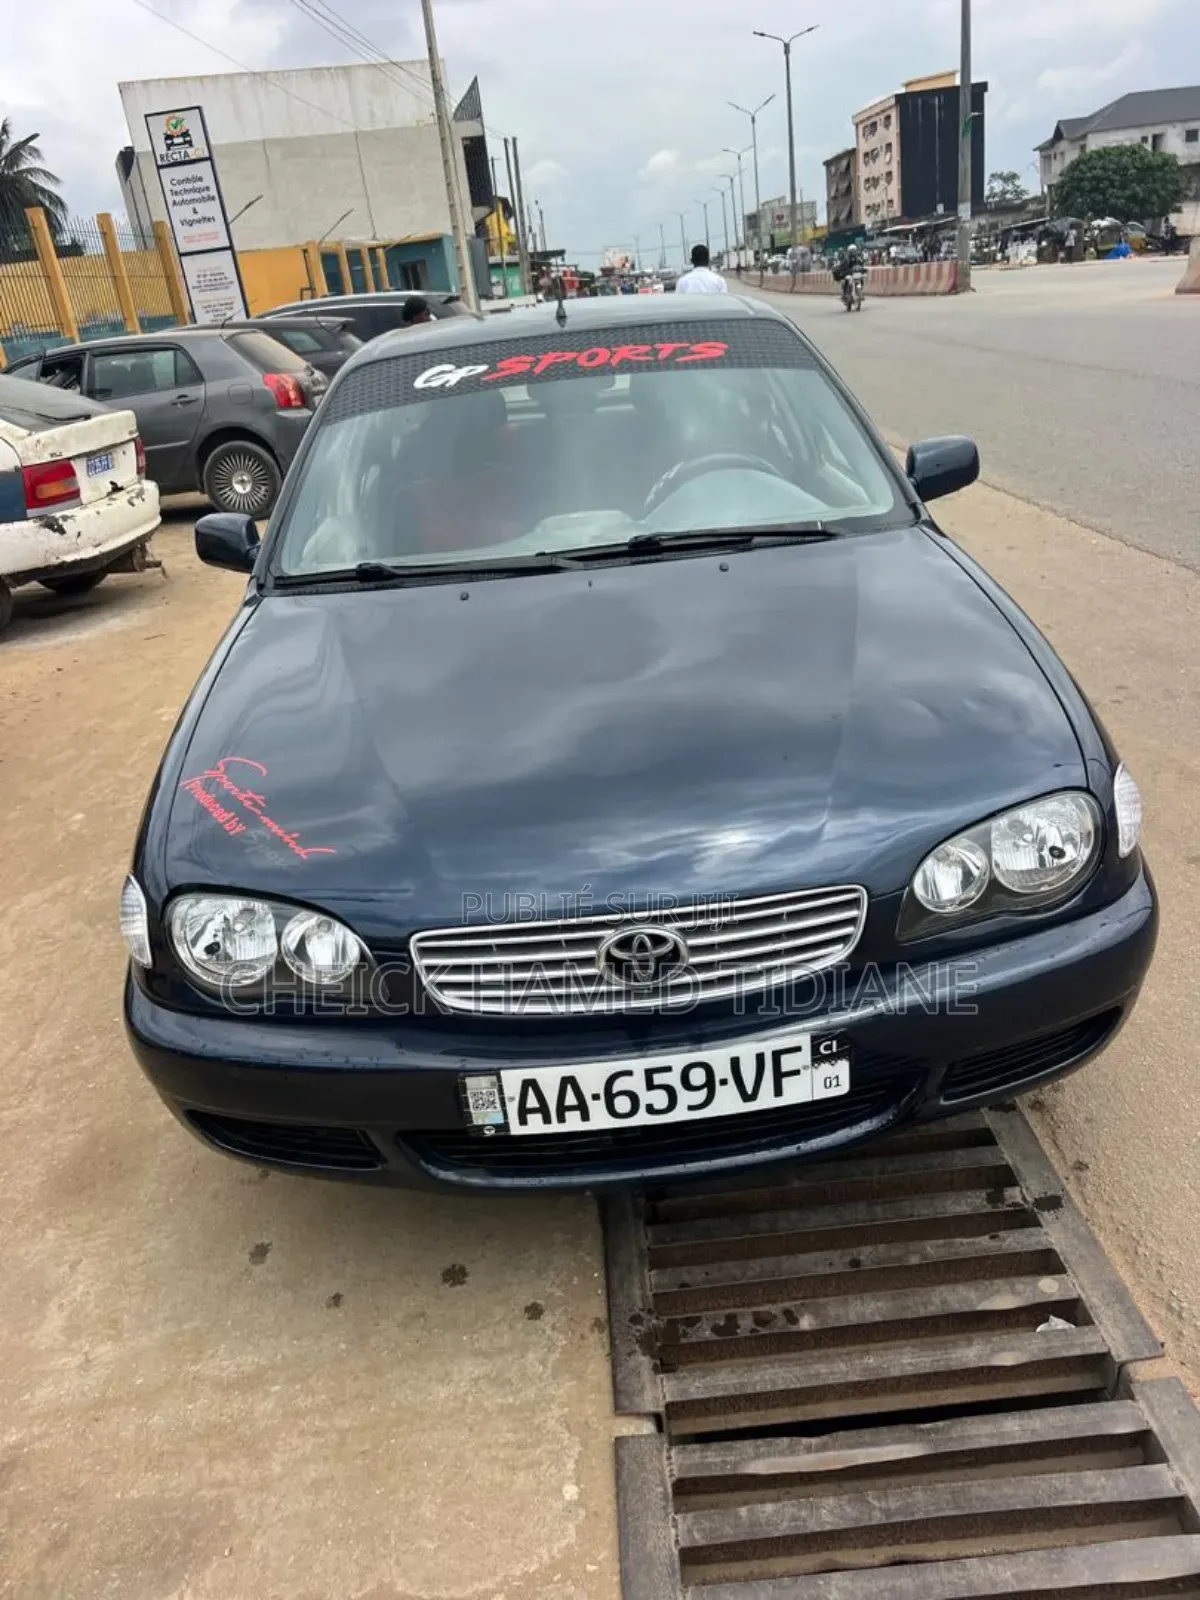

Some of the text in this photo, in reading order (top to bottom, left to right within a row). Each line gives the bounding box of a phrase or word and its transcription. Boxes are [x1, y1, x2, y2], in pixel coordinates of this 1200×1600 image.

[170, 174, 204, 187] Contrôle
[169, 185, 210, 198] Technique
[172, 194, 217, 208] Automobile
[179, 215, 216, 228] Vignettes
[818, 1039, 838, 1055] CI
[823, 1075, 842, 1090] 01
